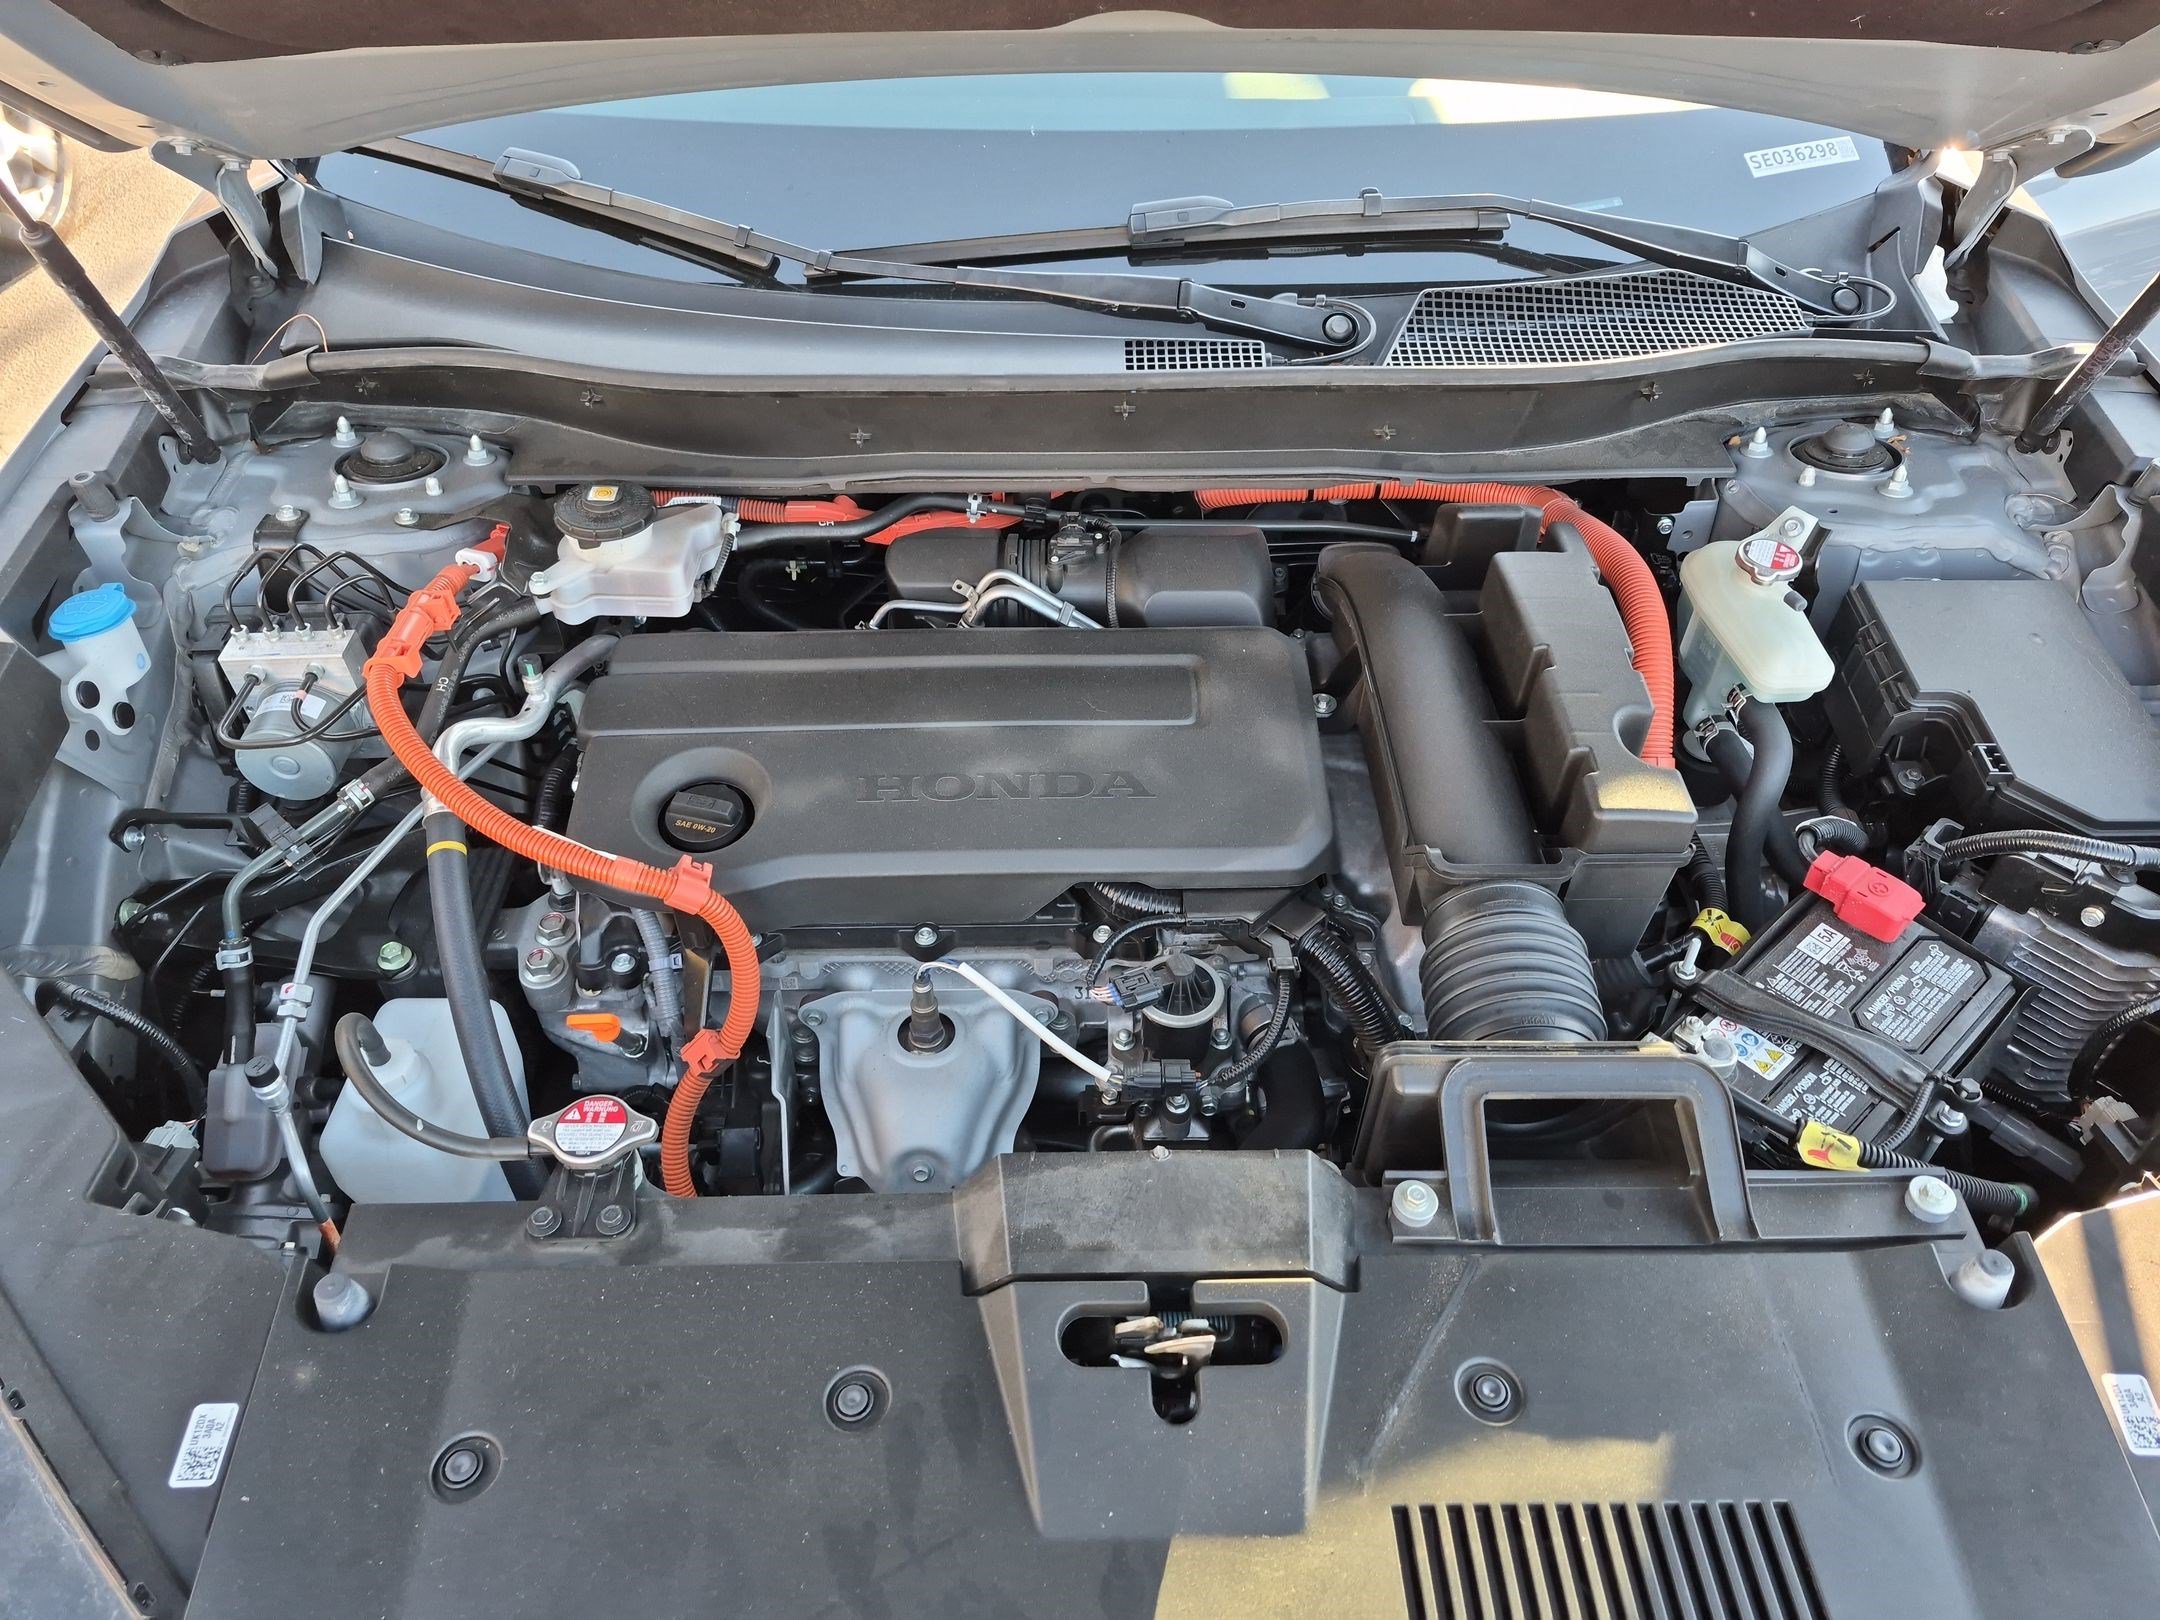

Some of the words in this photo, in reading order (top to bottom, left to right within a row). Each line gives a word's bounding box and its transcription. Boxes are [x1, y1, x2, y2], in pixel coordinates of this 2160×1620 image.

[1749, 142, 1838, 169] SE036298
[855, 770, 1158, 803] HONDA
[675, 820, 692, 828] SAE
[693, 823, 716, 833] 0W-20
[1819, 928, 1838, 942] 5A
